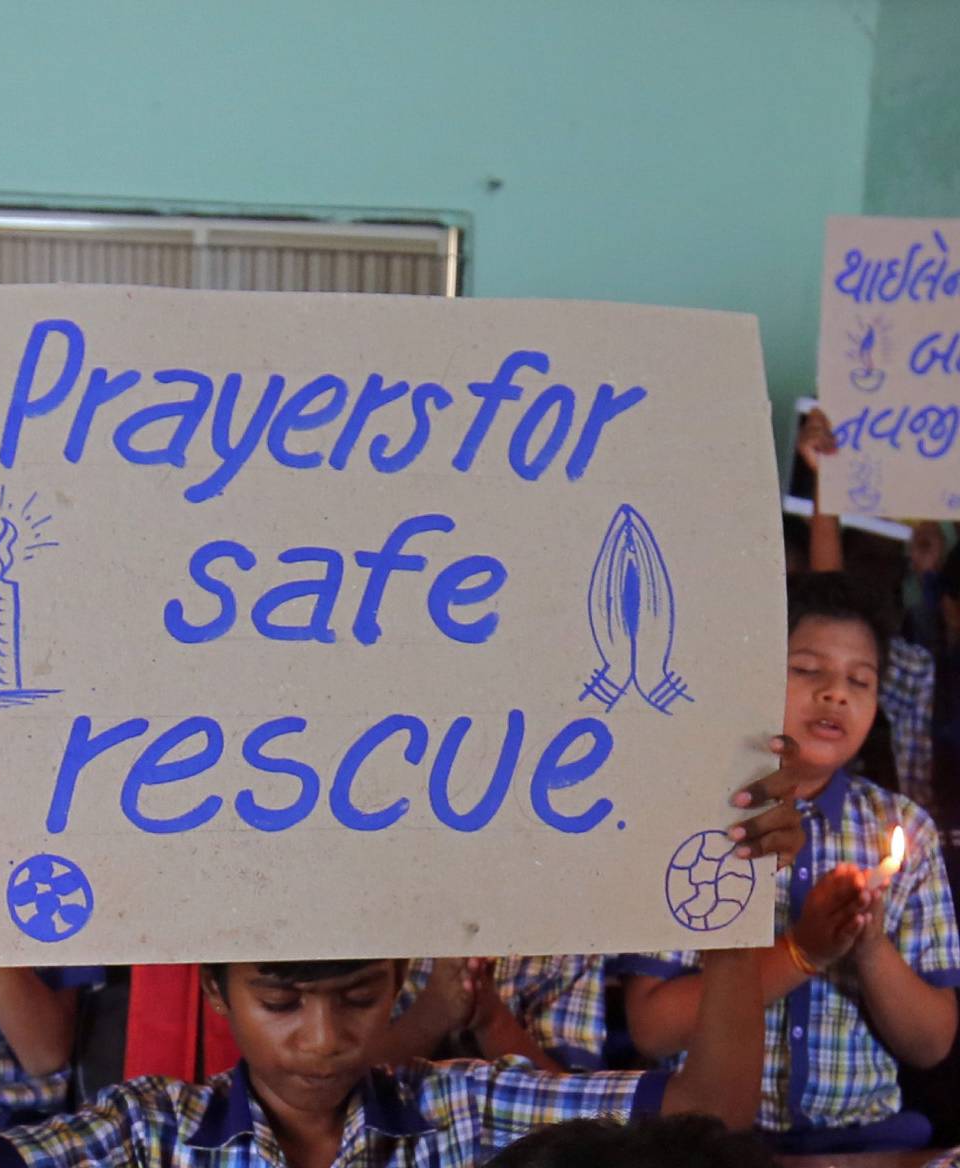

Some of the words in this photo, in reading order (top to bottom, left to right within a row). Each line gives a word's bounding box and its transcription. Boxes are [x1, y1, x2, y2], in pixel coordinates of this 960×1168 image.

[0, 320, 452, 503] Prayers
[453, 351, 647, 481] for
[164, 515, 508, 645] safe
[46, 710, 627, 834] rescue.
